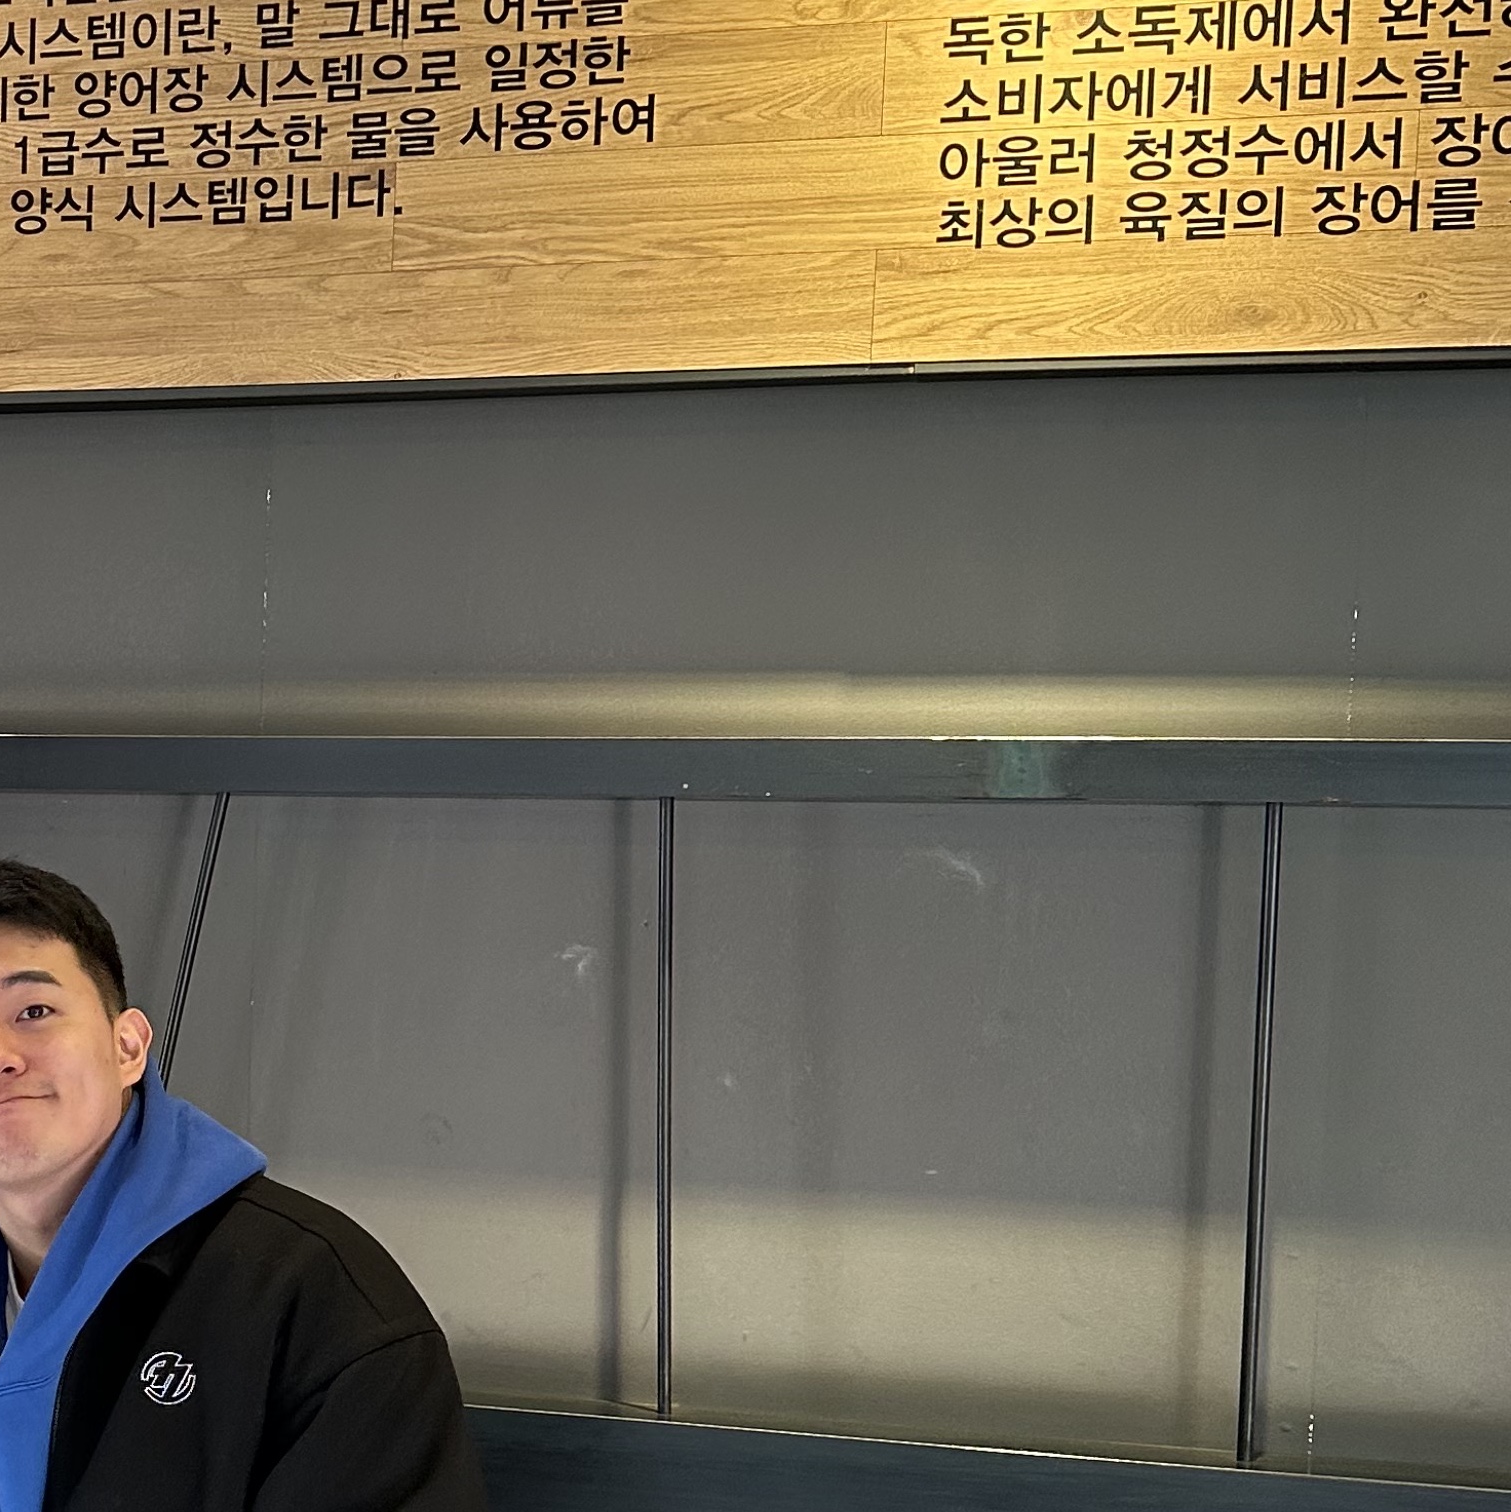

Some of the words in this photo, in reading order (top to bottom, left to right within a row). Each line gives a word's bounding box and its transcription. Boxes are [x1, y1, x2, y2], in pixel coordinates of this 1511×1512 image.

[257, 0, 300, 49] 말
[319, 0, 460, 39] 그대로
[944, 13, 1050, 64] 독한
[1073, 0, 1350, 54] 소독제에서
[75, 64, 208, 118] 양어장
[227, 50, 460, 107] 시스템으로
[486, 36, 630, 92] 일정한
[941, 65, 1210, 123] 소비자에게
[1238, 51, 1469, 111] 서비스할
[15, 127, 168, 176] 1급수로
[190, 115, 327, 168] 정수한
[347, 108, 440, 159] 물을
[460, 94, 655, 151] 사용하여
[941, 134, 1094, 187] 아울러
[1124, 118, 1402, 180] 청정수에서
[11, 185, 93, 234] 양식
[115, 169, 402, 228] 시스템입니다.
[937, 195, 1093, 248] 최상의
[1120, 186, 1283, 241] 육질의
[1312, 178, 1482, 235] 장어를
